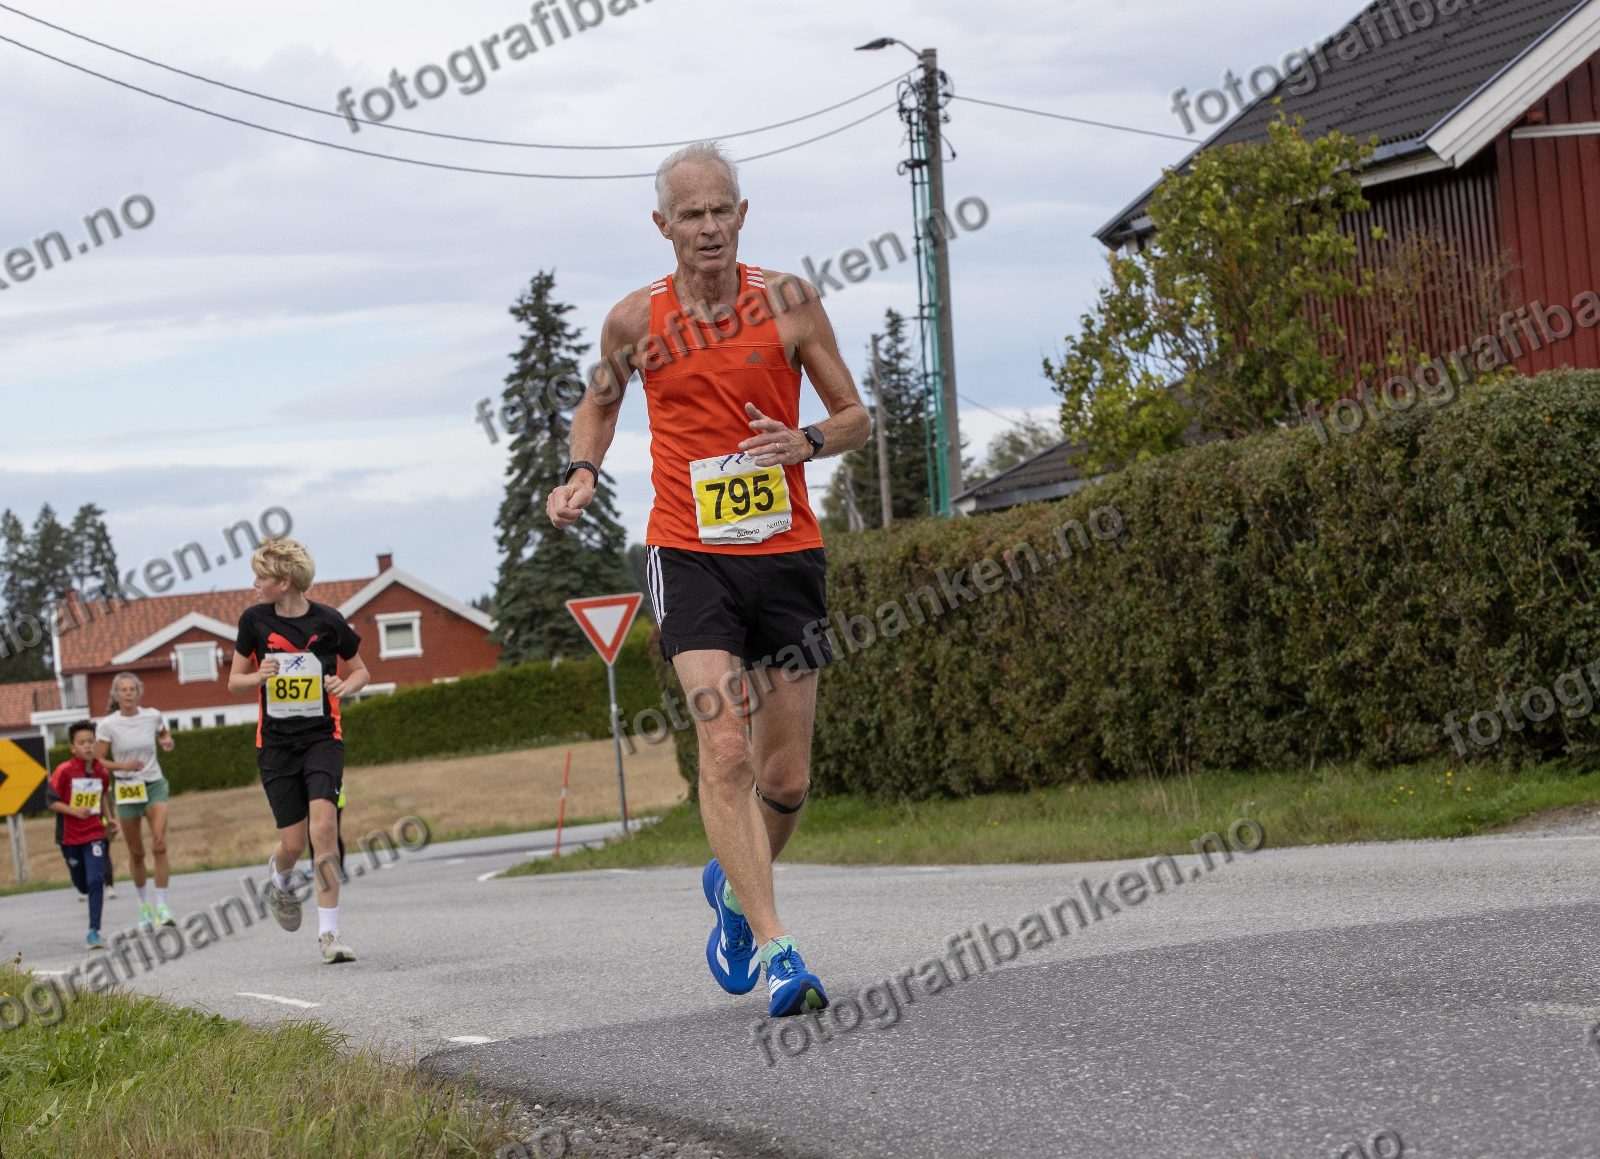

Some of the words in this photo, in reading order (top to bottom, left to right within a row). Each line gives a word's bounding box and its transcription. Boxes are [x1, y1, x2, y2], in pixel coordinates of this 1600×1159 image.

[705, 474, 774, 520] 795
[275, 678, 313, 699] 857
[120, 786, 141, 799] 934
